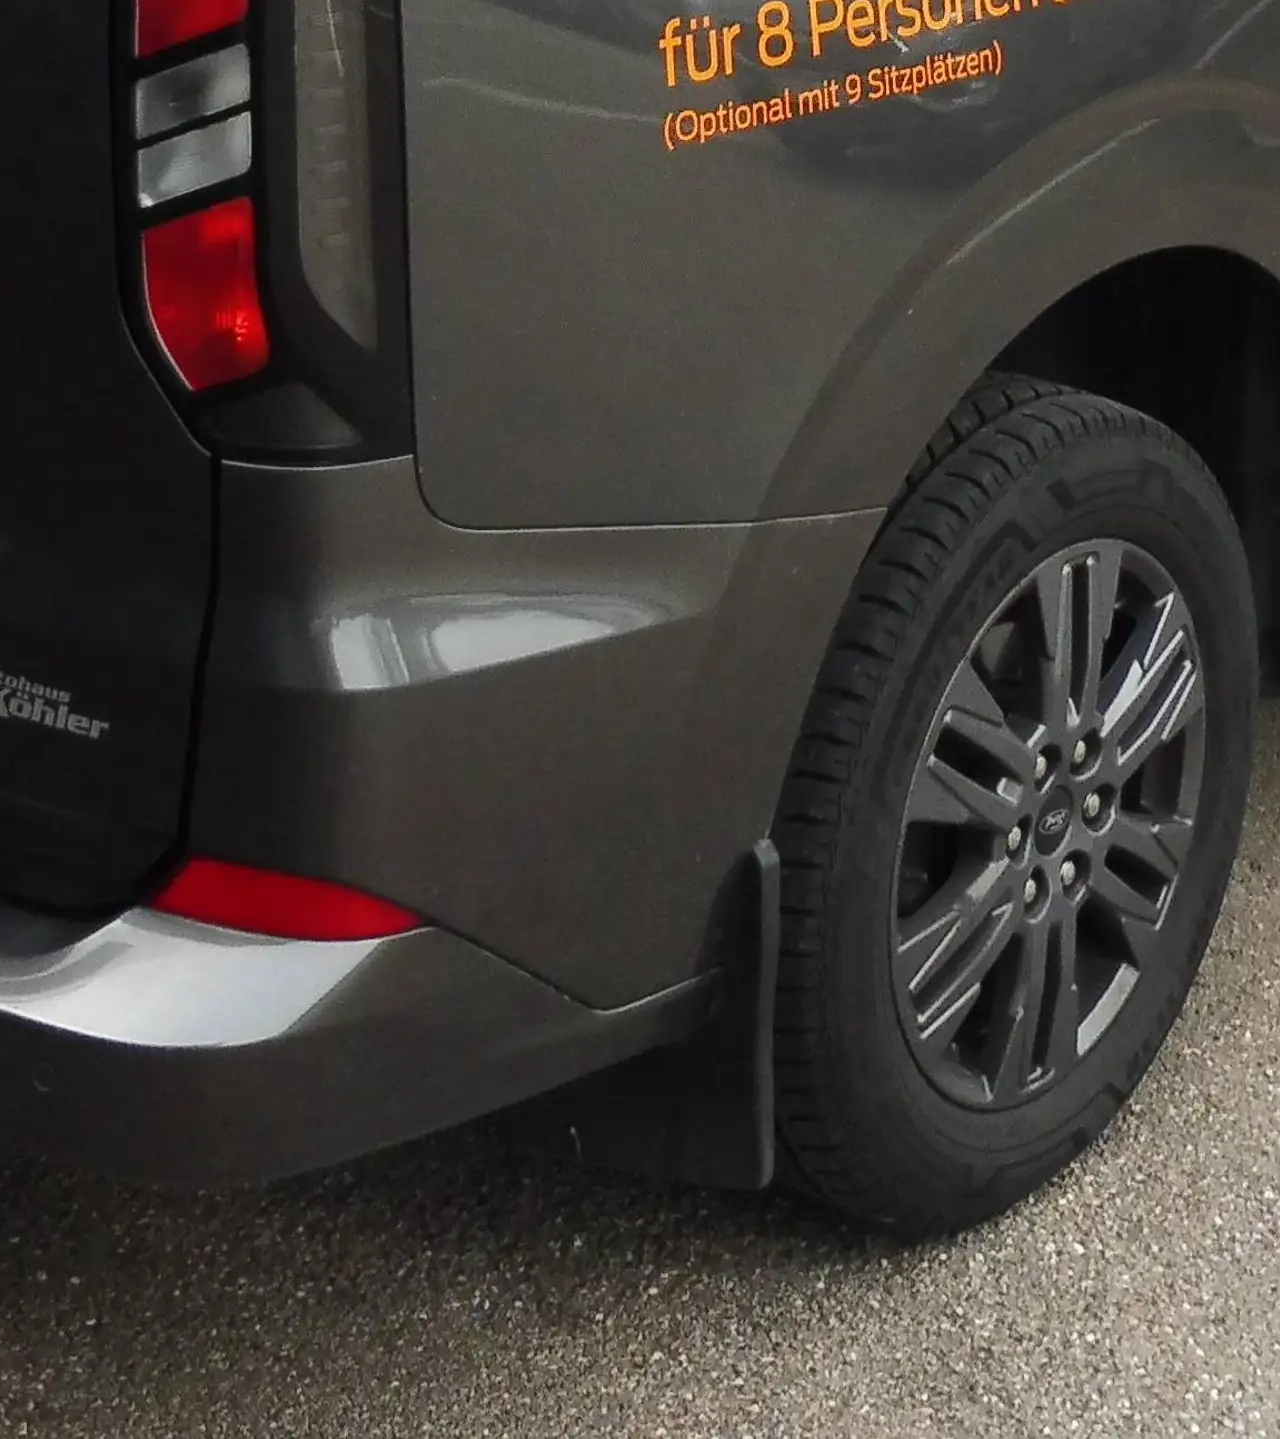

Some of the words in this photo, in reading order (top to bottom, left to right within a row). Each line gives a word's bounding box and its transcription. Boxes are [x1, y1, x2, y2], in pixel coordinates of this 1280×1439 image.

[658, 14, 741, 88] für
[756, 0, 794, 68] 8
[663, 88, 793, 151] (Optional
[796, 77, 841, 116] mit
[846, 72, 863, 105] 9
[866, 38, 1005, 104] Sitzplätzen)
